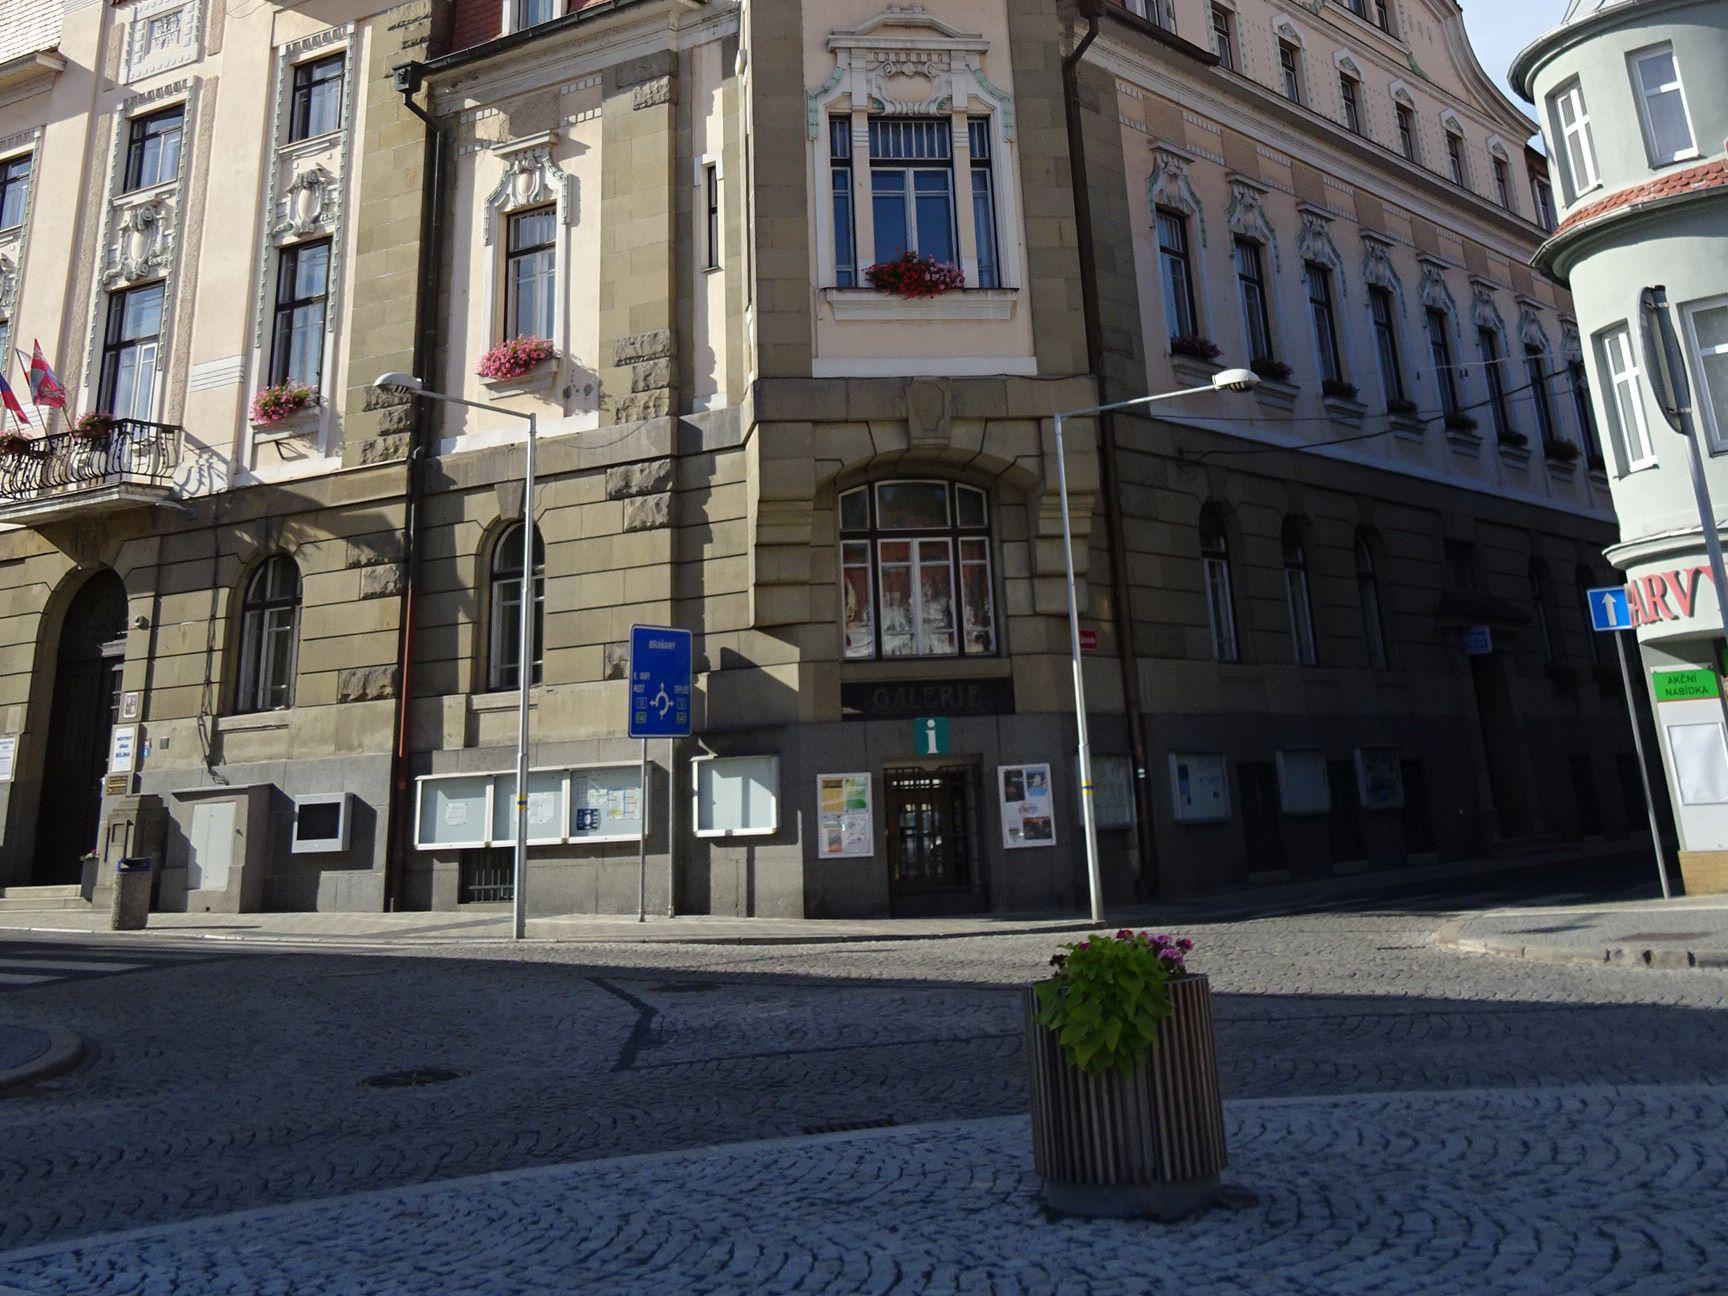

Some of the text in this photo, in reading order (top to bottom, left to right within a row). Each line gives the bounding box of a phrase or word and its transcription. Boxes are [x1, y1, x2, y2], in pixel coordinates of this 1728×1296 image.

[1667, 671, 1698, 685] AKČNÍ
[875, 686, 981, 708] GALERIE
[1664, 685, 1709, 698] NABÍDKA
